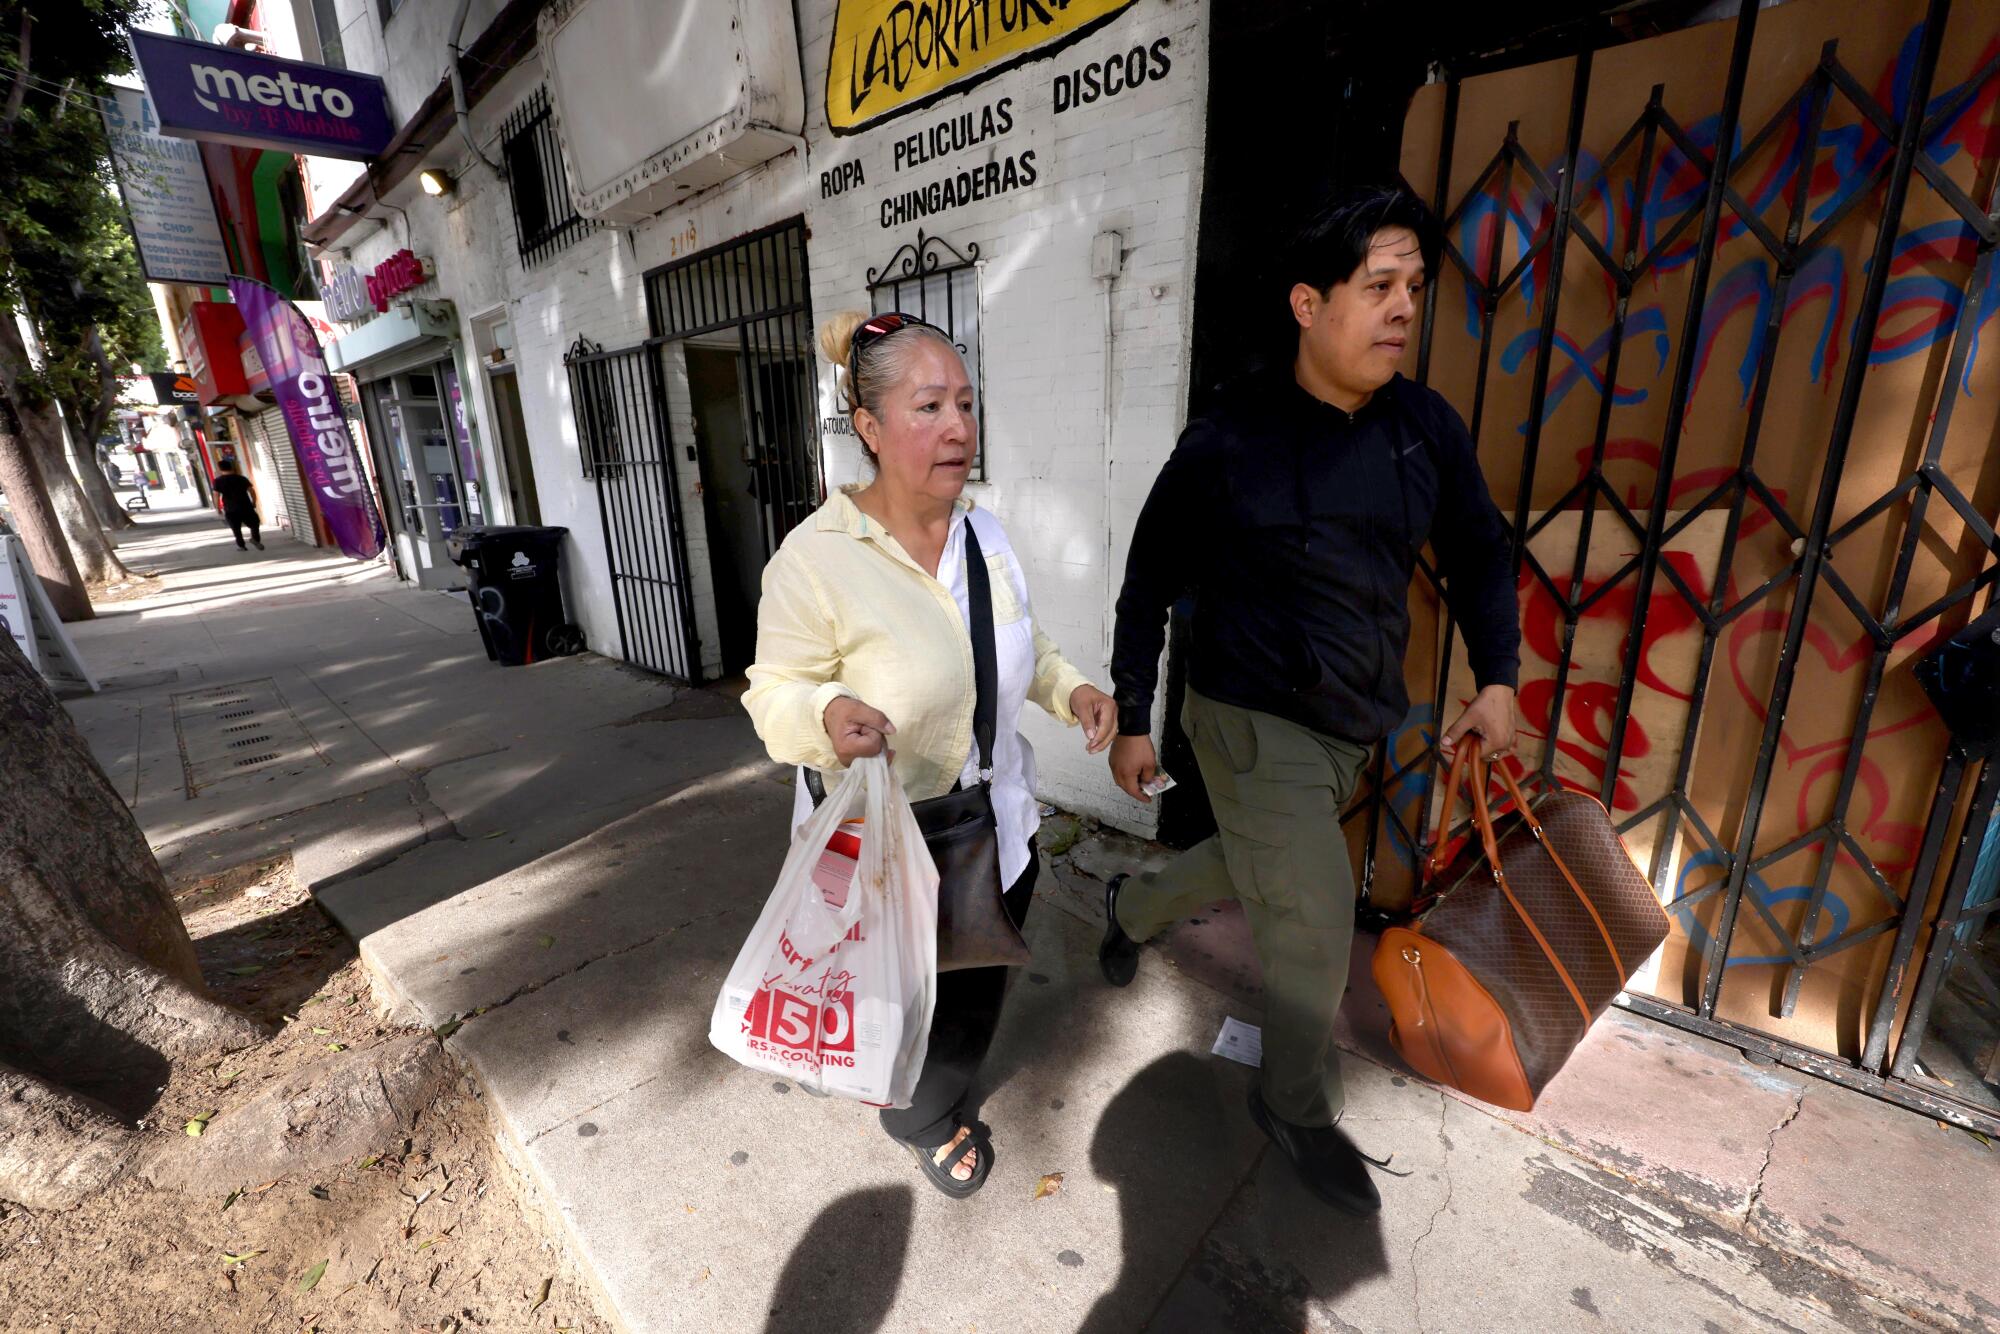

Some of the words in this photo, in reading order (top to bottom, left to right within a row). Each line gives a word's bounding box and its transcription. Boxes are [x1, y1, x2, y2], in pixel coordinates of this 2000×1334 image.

[190, 63, 354, 118] metro
[223, 102, 252, 130] by
[286, 110, 361, 141] Mobile
[821, 158, 865, 199] ROPA
[894, 97, 1013, 172] PELICULAS
[1053, 36, 1171, 115] DISCOS
[880, 150, 1037, 228] CHINGADERAS
